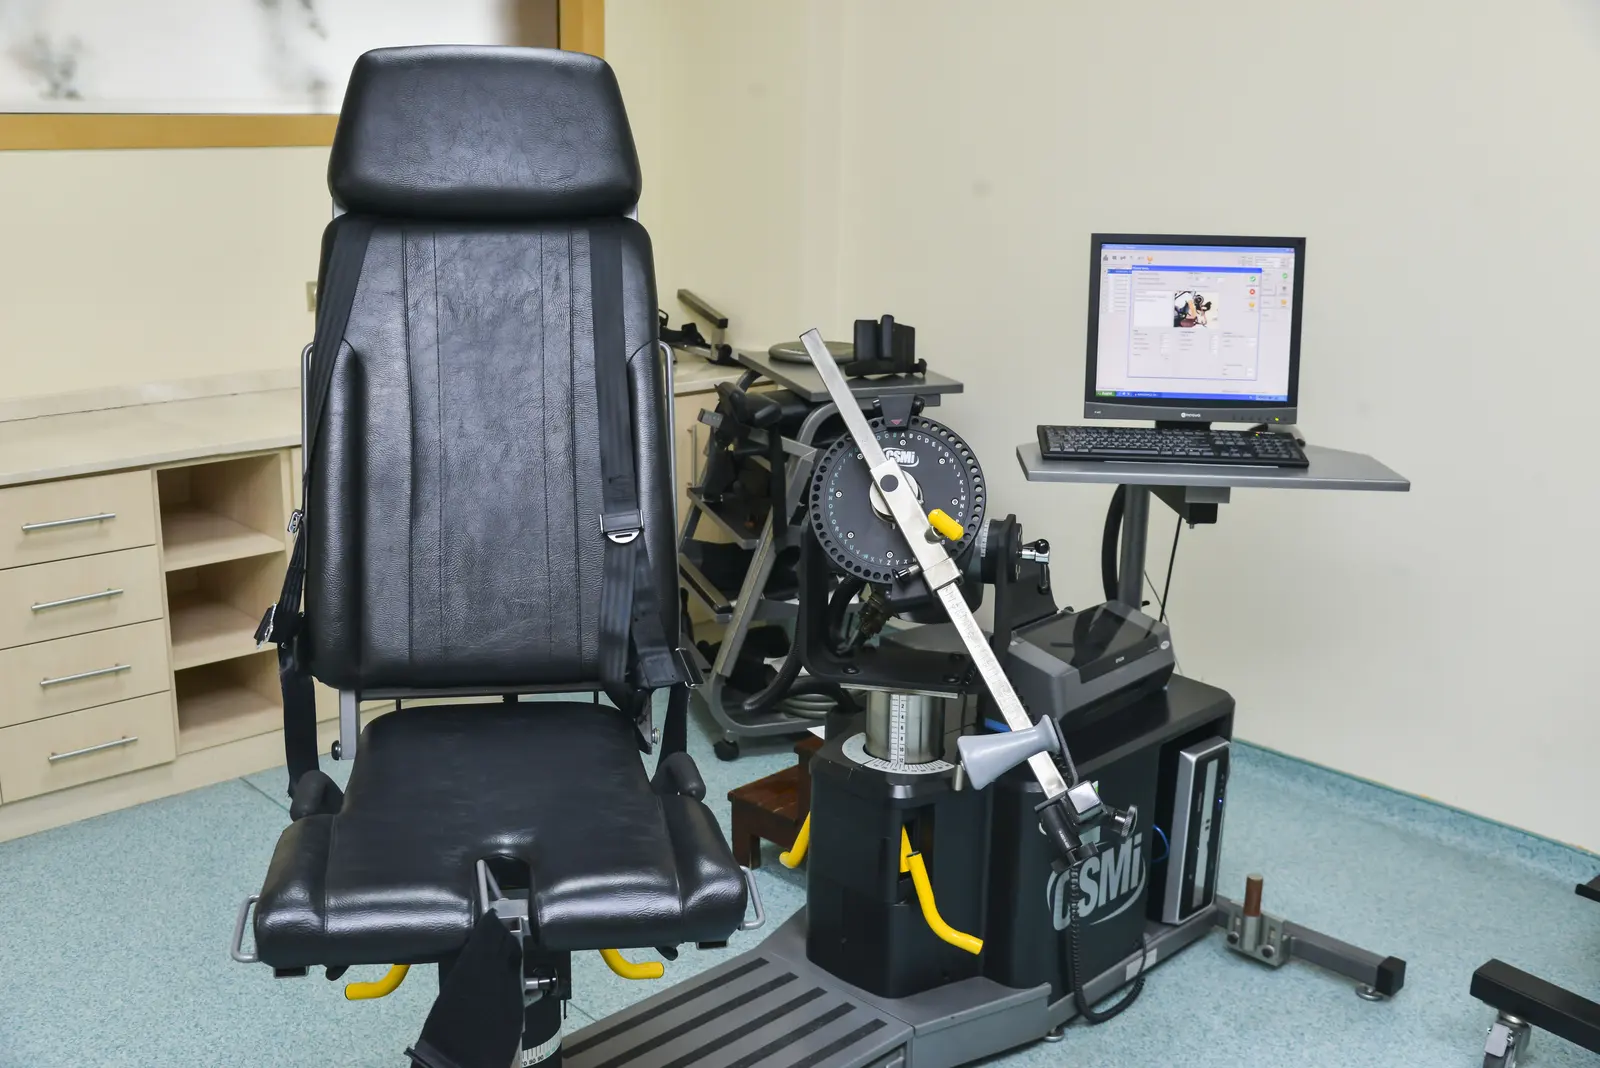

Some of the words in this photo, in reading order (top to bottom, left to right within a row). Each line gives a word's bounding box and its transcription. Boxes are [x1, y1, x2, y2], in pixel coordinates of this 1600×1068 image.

[885, 450, 916, 464] CSMi
[1053, 832, 1142, 931] CSMi
[537, 1054, 545, 1062] 90
